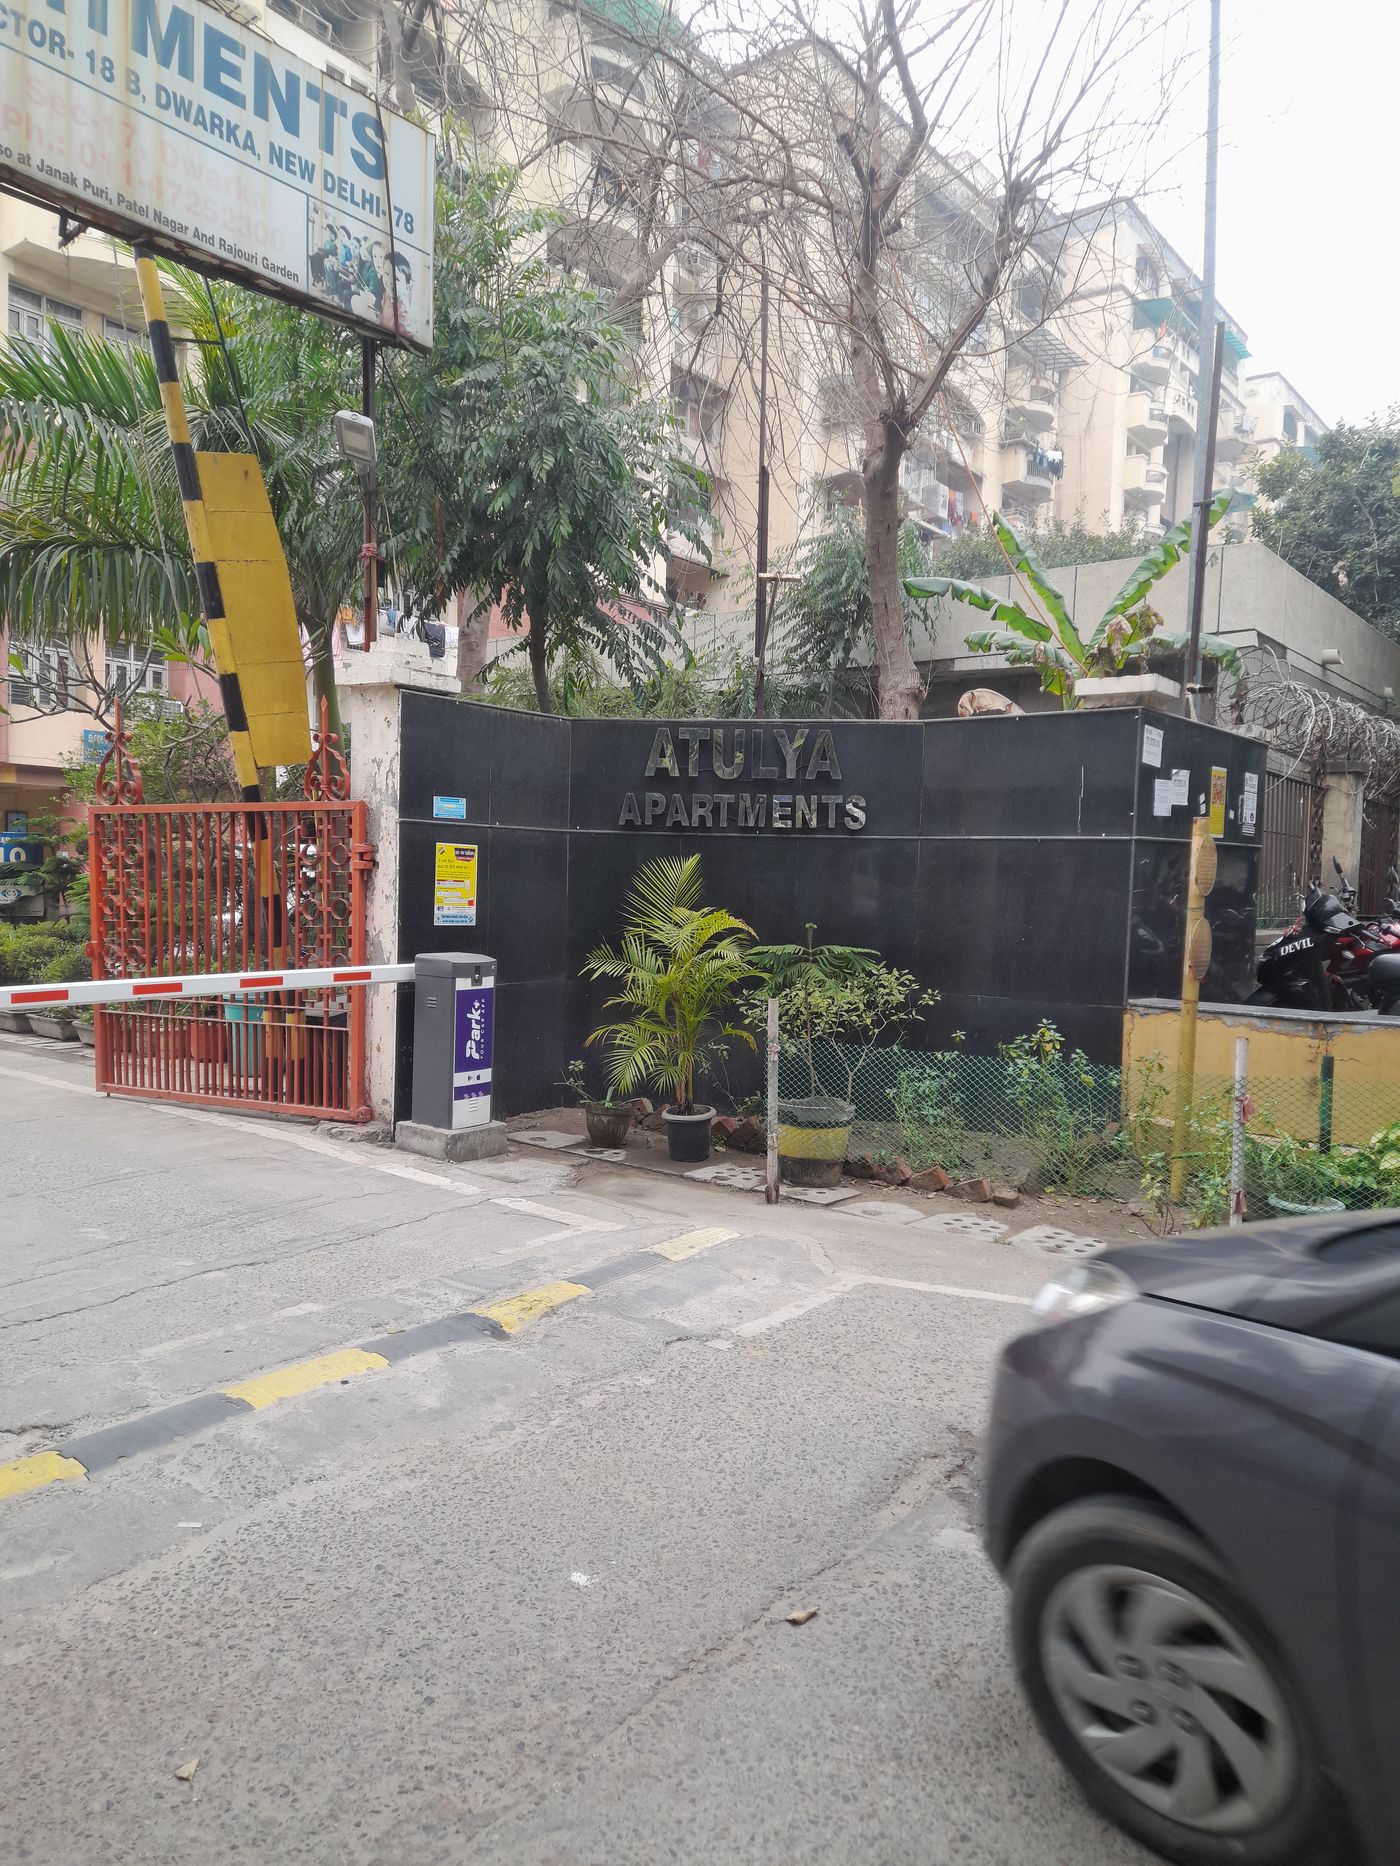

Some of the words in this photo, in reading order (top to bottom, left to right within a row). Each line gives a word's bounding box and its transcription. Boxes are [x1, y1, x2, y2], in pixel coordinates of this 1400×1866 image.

[46, 0, 388, 180] MENTS
[86, 49, 115, 83] 18
[155, 82, 261, 161] DWARKA,
[268, 140, 316, 184] NEW
[393, 205, 414, 234] 78
[17, 152, 32, 168] at
[36, 158, 79, 188] Janak
[83, 177, 113, 205] Puri,
[117, 192, 149, 219] Patel
[153, 208, 189, 235] Nagar
[193, 226, 215, 247] And
[219, 237, 258, 266] Rajouri
[262, 256, 299, 284] Garden
[644, 727, 842, 780] ATULYA
[618, 792, 867, 830] APARTMENTS
[1281, 937, 1314, 957] DEVIL
